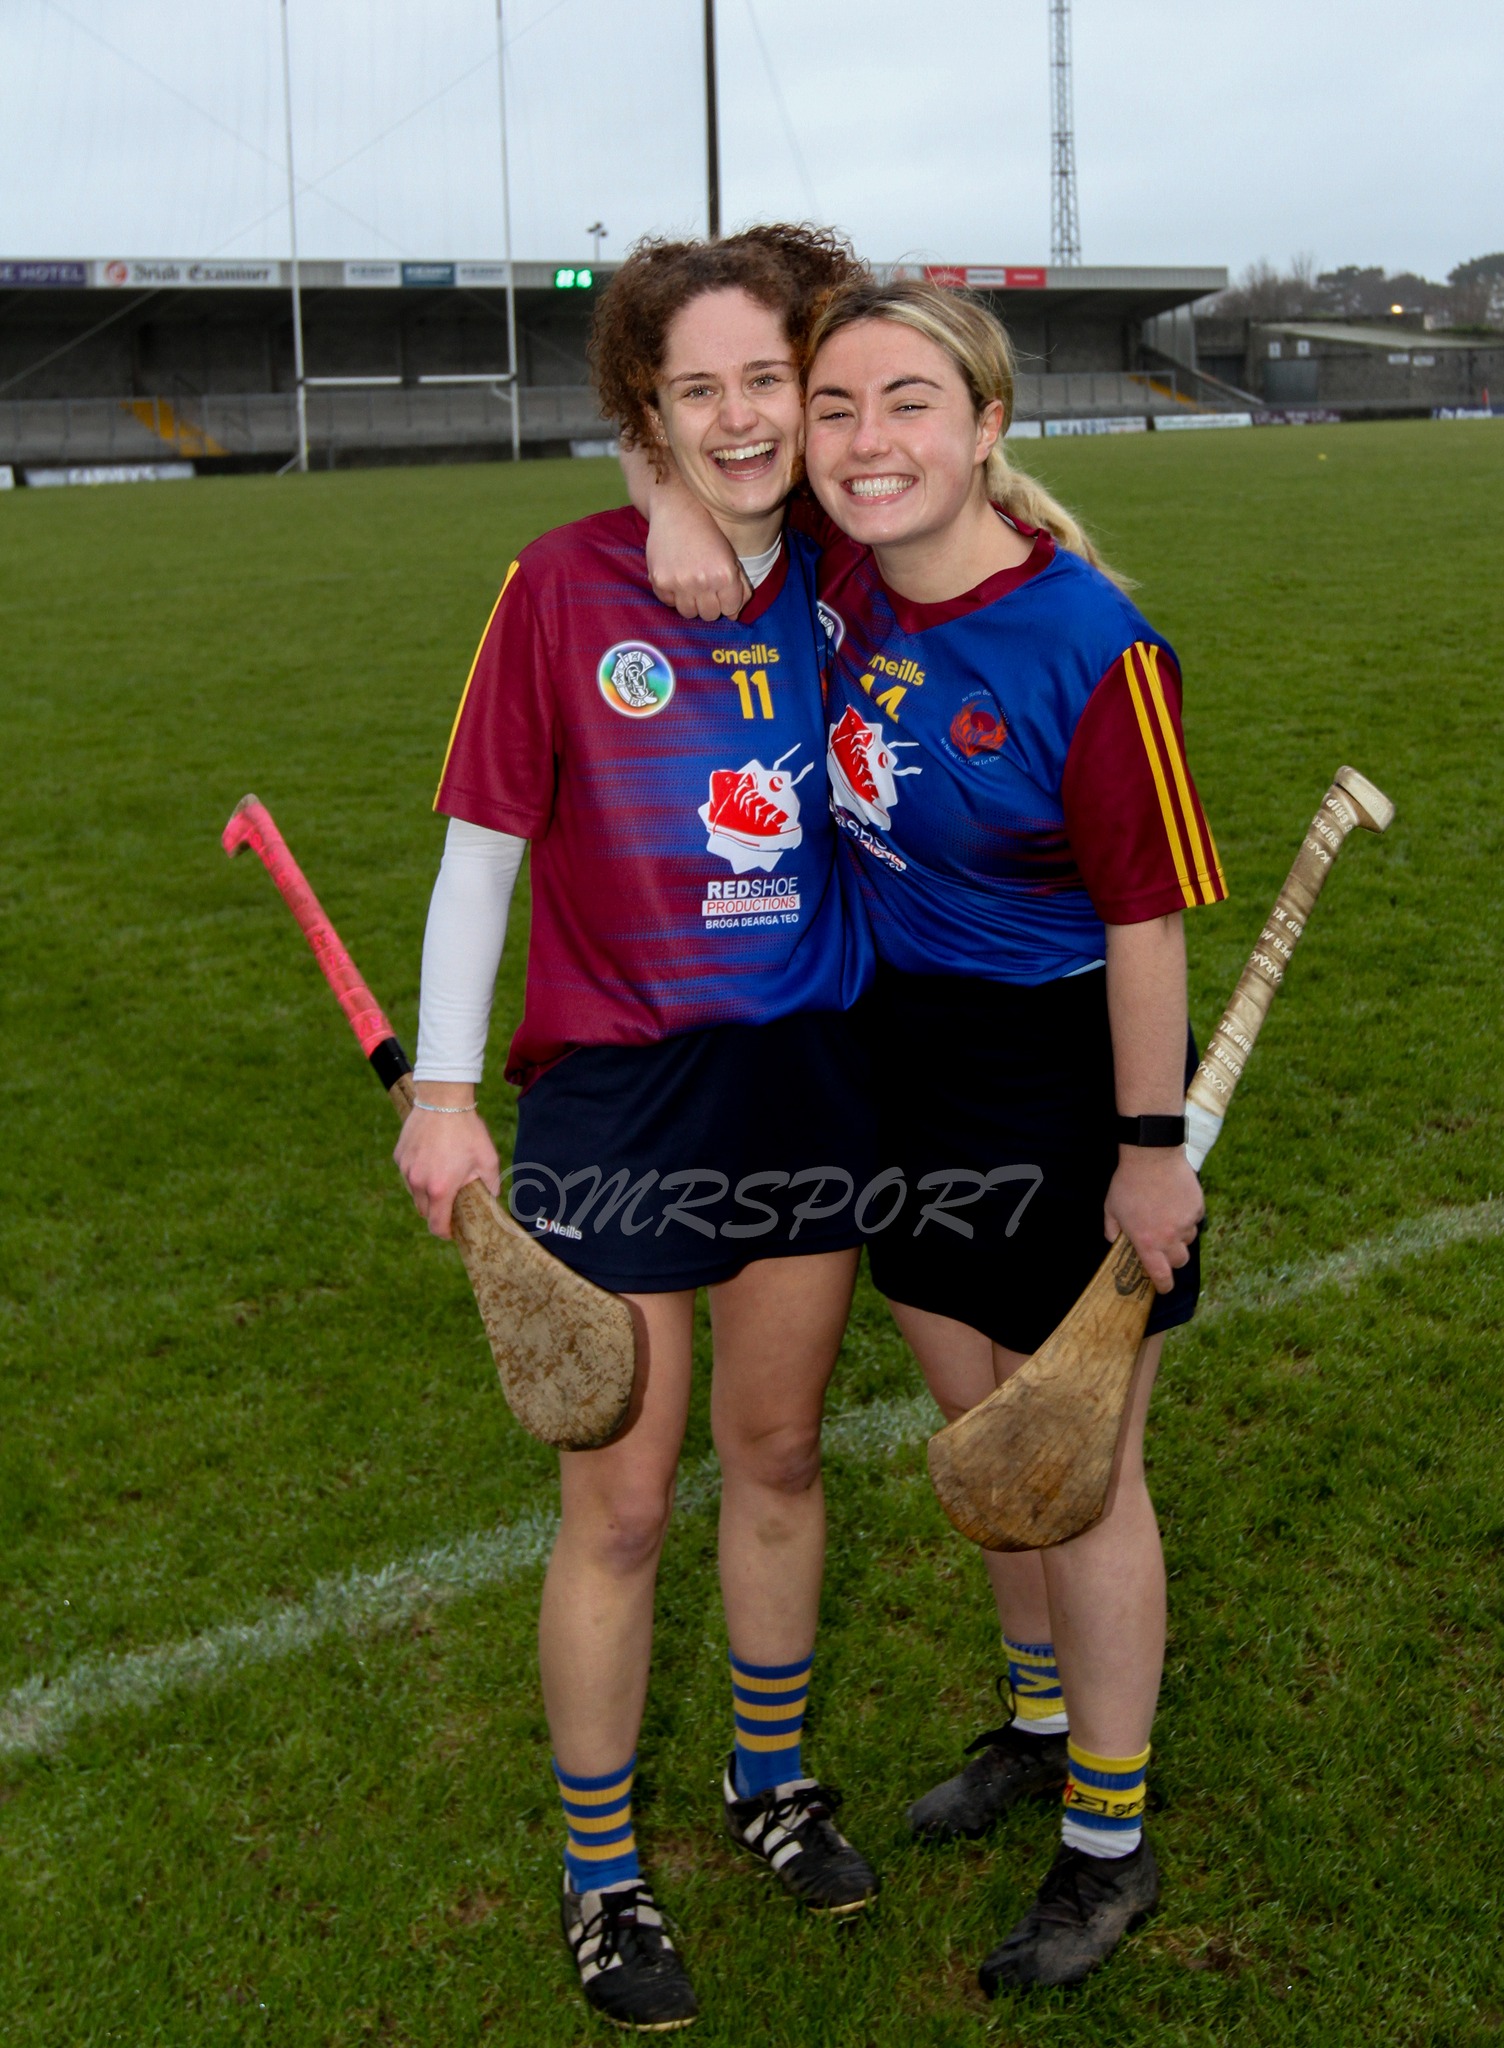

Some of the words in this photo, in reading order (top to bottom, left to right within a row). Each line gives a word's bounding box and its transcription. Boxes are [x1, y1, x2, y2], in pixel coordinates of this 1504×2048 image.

[20, 264, 84, 280] HOTEL
[188, 263, 270, 281] Examiner
[731, 669, 774, 720] 11
[706, 896, 797, 915] PRODUCTIONS
[705, 916, 740, 930] BRÓGA
[741, 915, 780, 927] DEARGA
[780, 913, 799, 924] TEO
[1220, 1020, 1235, 1035] XL
[1214, 1046, 1242, 1079] UPER
